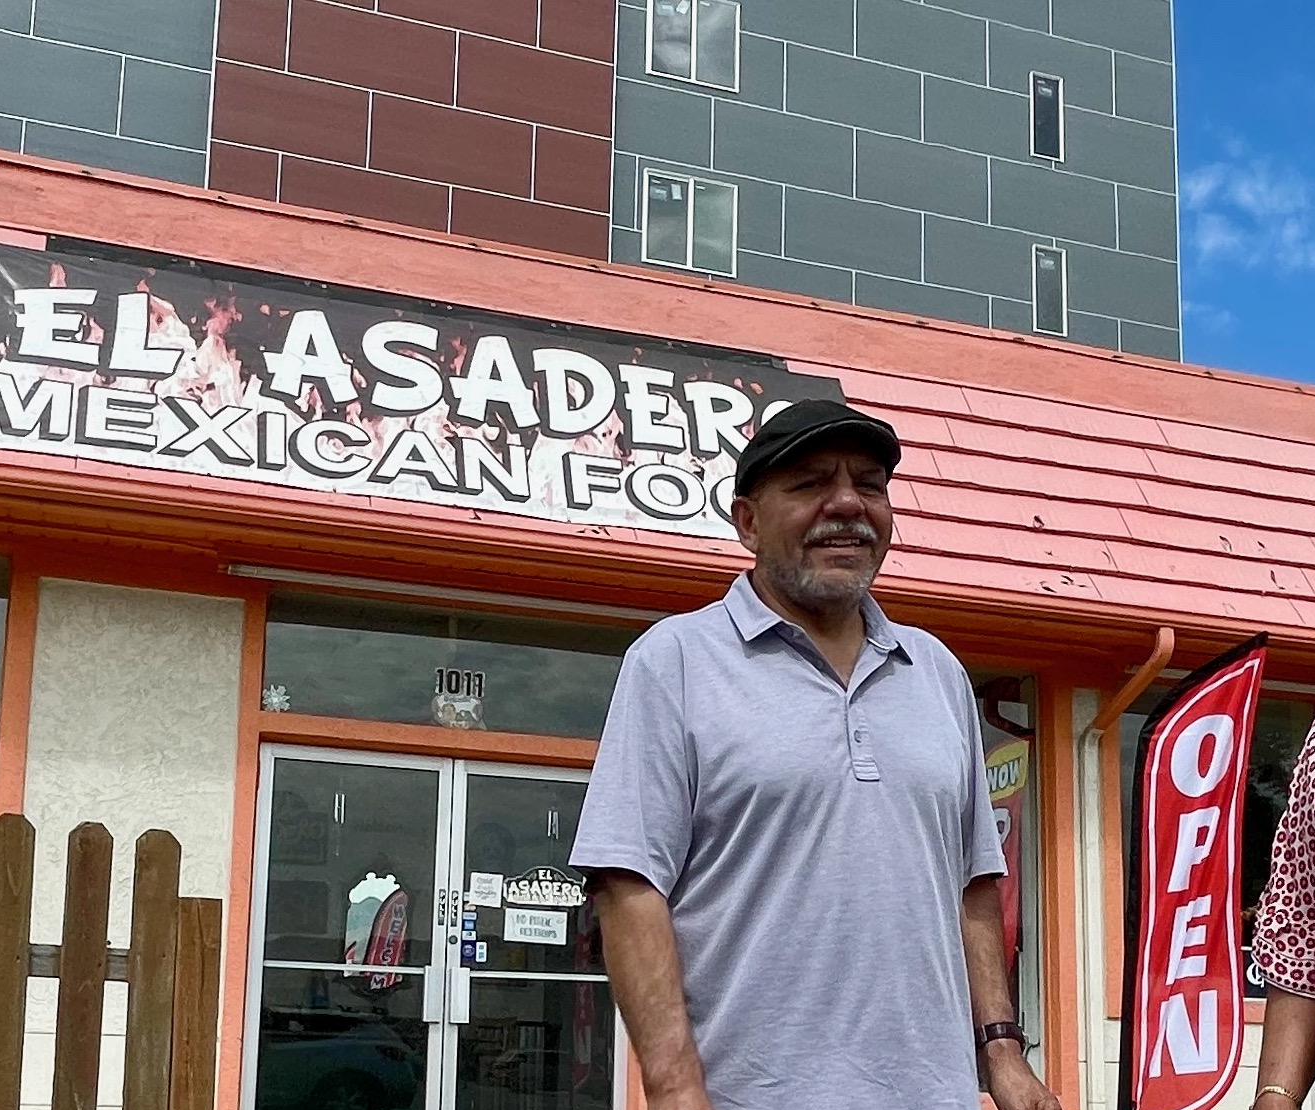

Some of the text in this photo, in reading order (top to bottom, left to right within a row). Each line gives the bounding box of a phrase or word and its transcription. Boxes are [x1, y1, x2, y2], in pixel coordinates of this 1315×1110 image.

[14, 288, 793, 458] EL ASADER
[436, 668, 483, 698] 1011
[508, 880, 582, 899] ASADERO
[538, 869, 553, 880] EL
[1148, 713, 1235, 1078] OPEN
